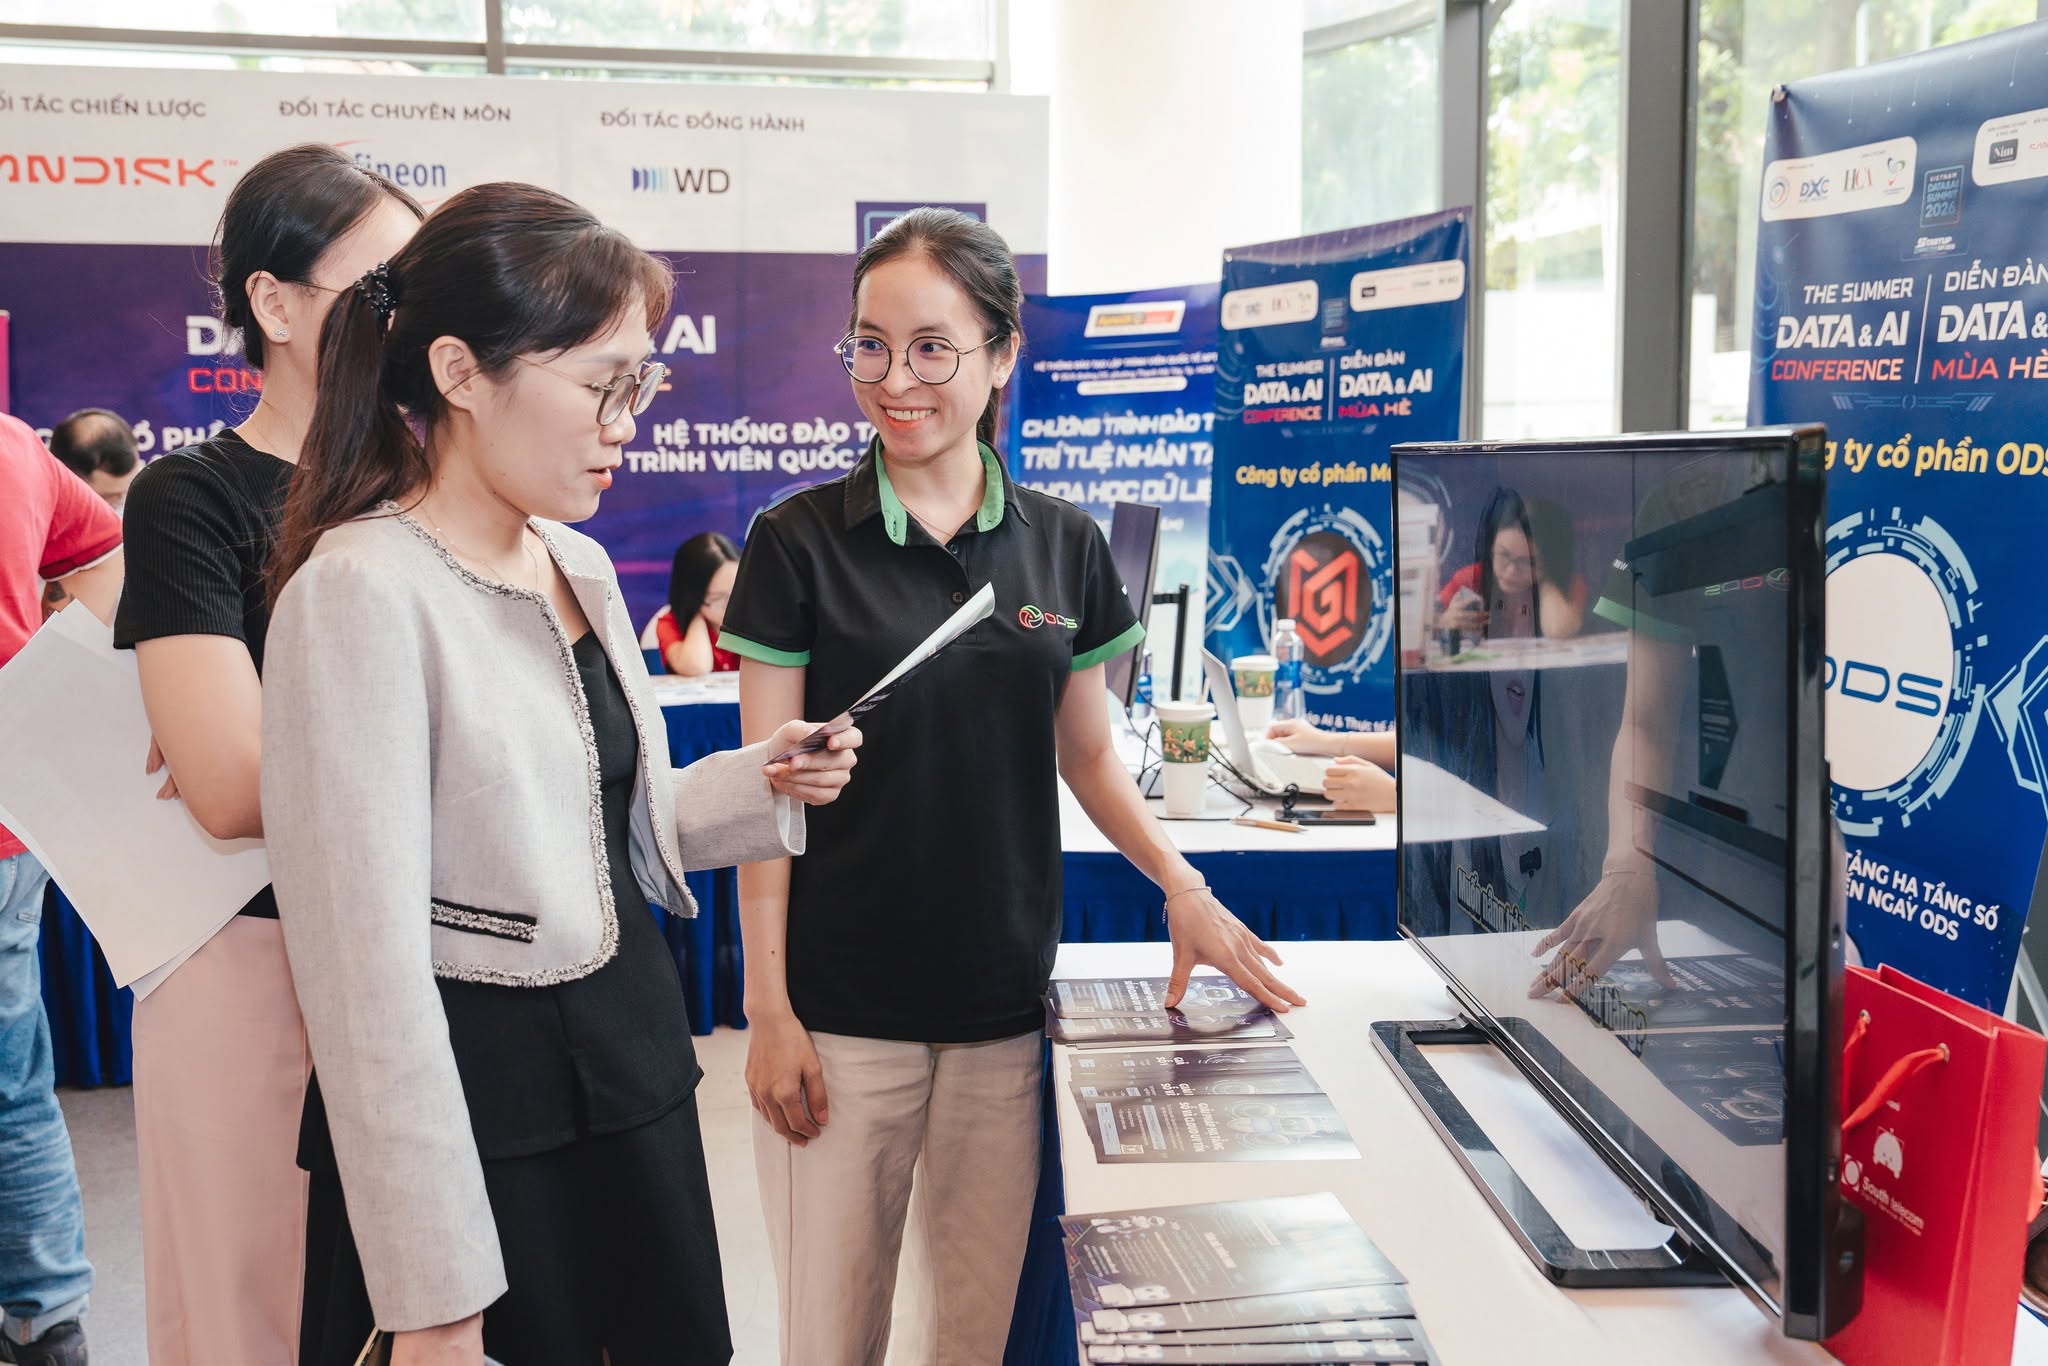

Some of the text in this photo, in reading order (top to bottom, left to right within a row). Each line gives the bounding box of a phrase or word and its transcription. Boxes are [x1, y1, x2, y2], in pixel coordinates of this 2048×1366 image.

[21, 93, 64, 113] TÁC
[70, 94, 140, 116] CHIẾN
[146, 99, 207, 119] LƯỢC
[279, 97, 511, 121] ĐỐI TÁC CHUYÊN MÔN
[601, 108, 805, 131] ĐỐI TÁC ĐỒNG HÀNH
[674, 168, 730, 193] WD
[1800, 176, 1829, 198] DXC
[1925, 201, 1956, 218] 2026
[1944, 258, 1998, 292] DIỄN
[1803, 277, 1914, 304] THE SUMMER
[662, 314, 716, 354] AI
[1775, 310, 1910, 350] DATA & AI
[1937, 300, 2028, 343] DATA
[1255, 359, 1323, 378] THE SUMMER
[1771, 358, 1904, 382] CONFERENCE
[1931, 352, 1999, 380] MÙA
[1244, 381, 1291, 406] DATA
[1301, 378, 1323, 401] AI
[1339, 371, 1394, 398] DATA
[1407, 368, 1433, 394] AI
[1243, 405, 1322, 424] CONFERENCE
[1338, 401, 1380, 418] MÙA
[653, 418, 690, 449] HỆ
[694, 416, 787, 445] THỐNG
[791, 416, 849, 445] ĐÀO
[624, 446, 706, 473] TRÌNH
[711, 445, 773, 472] VIÊN
[778, 442, 855, 475] QUỐC
[1115, 437, 1188, 468] NHÂN
[1844, 437, 1873, 473] ty
[1876, 432, 1912, 469] cổ
[1914, 436, 1988, 477] phần
[1995, 441, 2048, 477] OD
[1279, 465, 1298, 488] ty
[1044, 612, 1078, 628] ODS
[1825, 655, 1943, 717] DS
[1867, 886, 1919, 922] NGAY
[1920, 909, 1960, 941] ODS
[1973, 904, 2000, 931] SỐ
[1862, 1176, 1890, 1206] South
[1890, 1197, 1924, 1230] telecom
